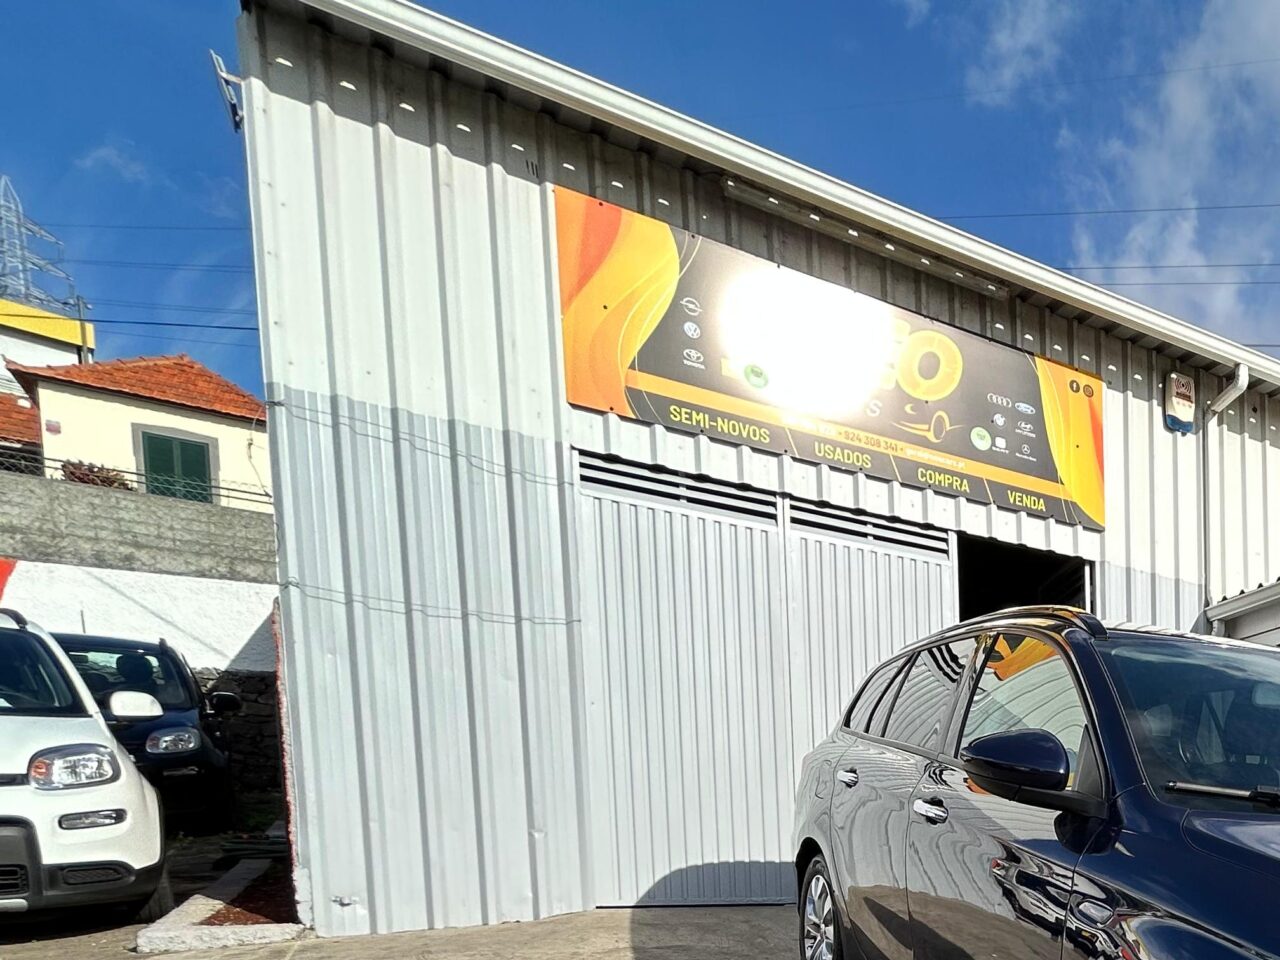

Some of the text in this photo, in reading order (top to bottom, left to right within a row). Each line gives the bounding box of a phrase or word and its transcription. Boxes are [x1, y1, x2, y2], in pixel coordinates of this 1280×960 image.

[669, 404, 770, 444] SEMI-NOVOS
[814, 441, 872, 468] USADOS
[917, 467, 970, 493] COMPRA
[1007, 489, 1046, 512] VENDA
